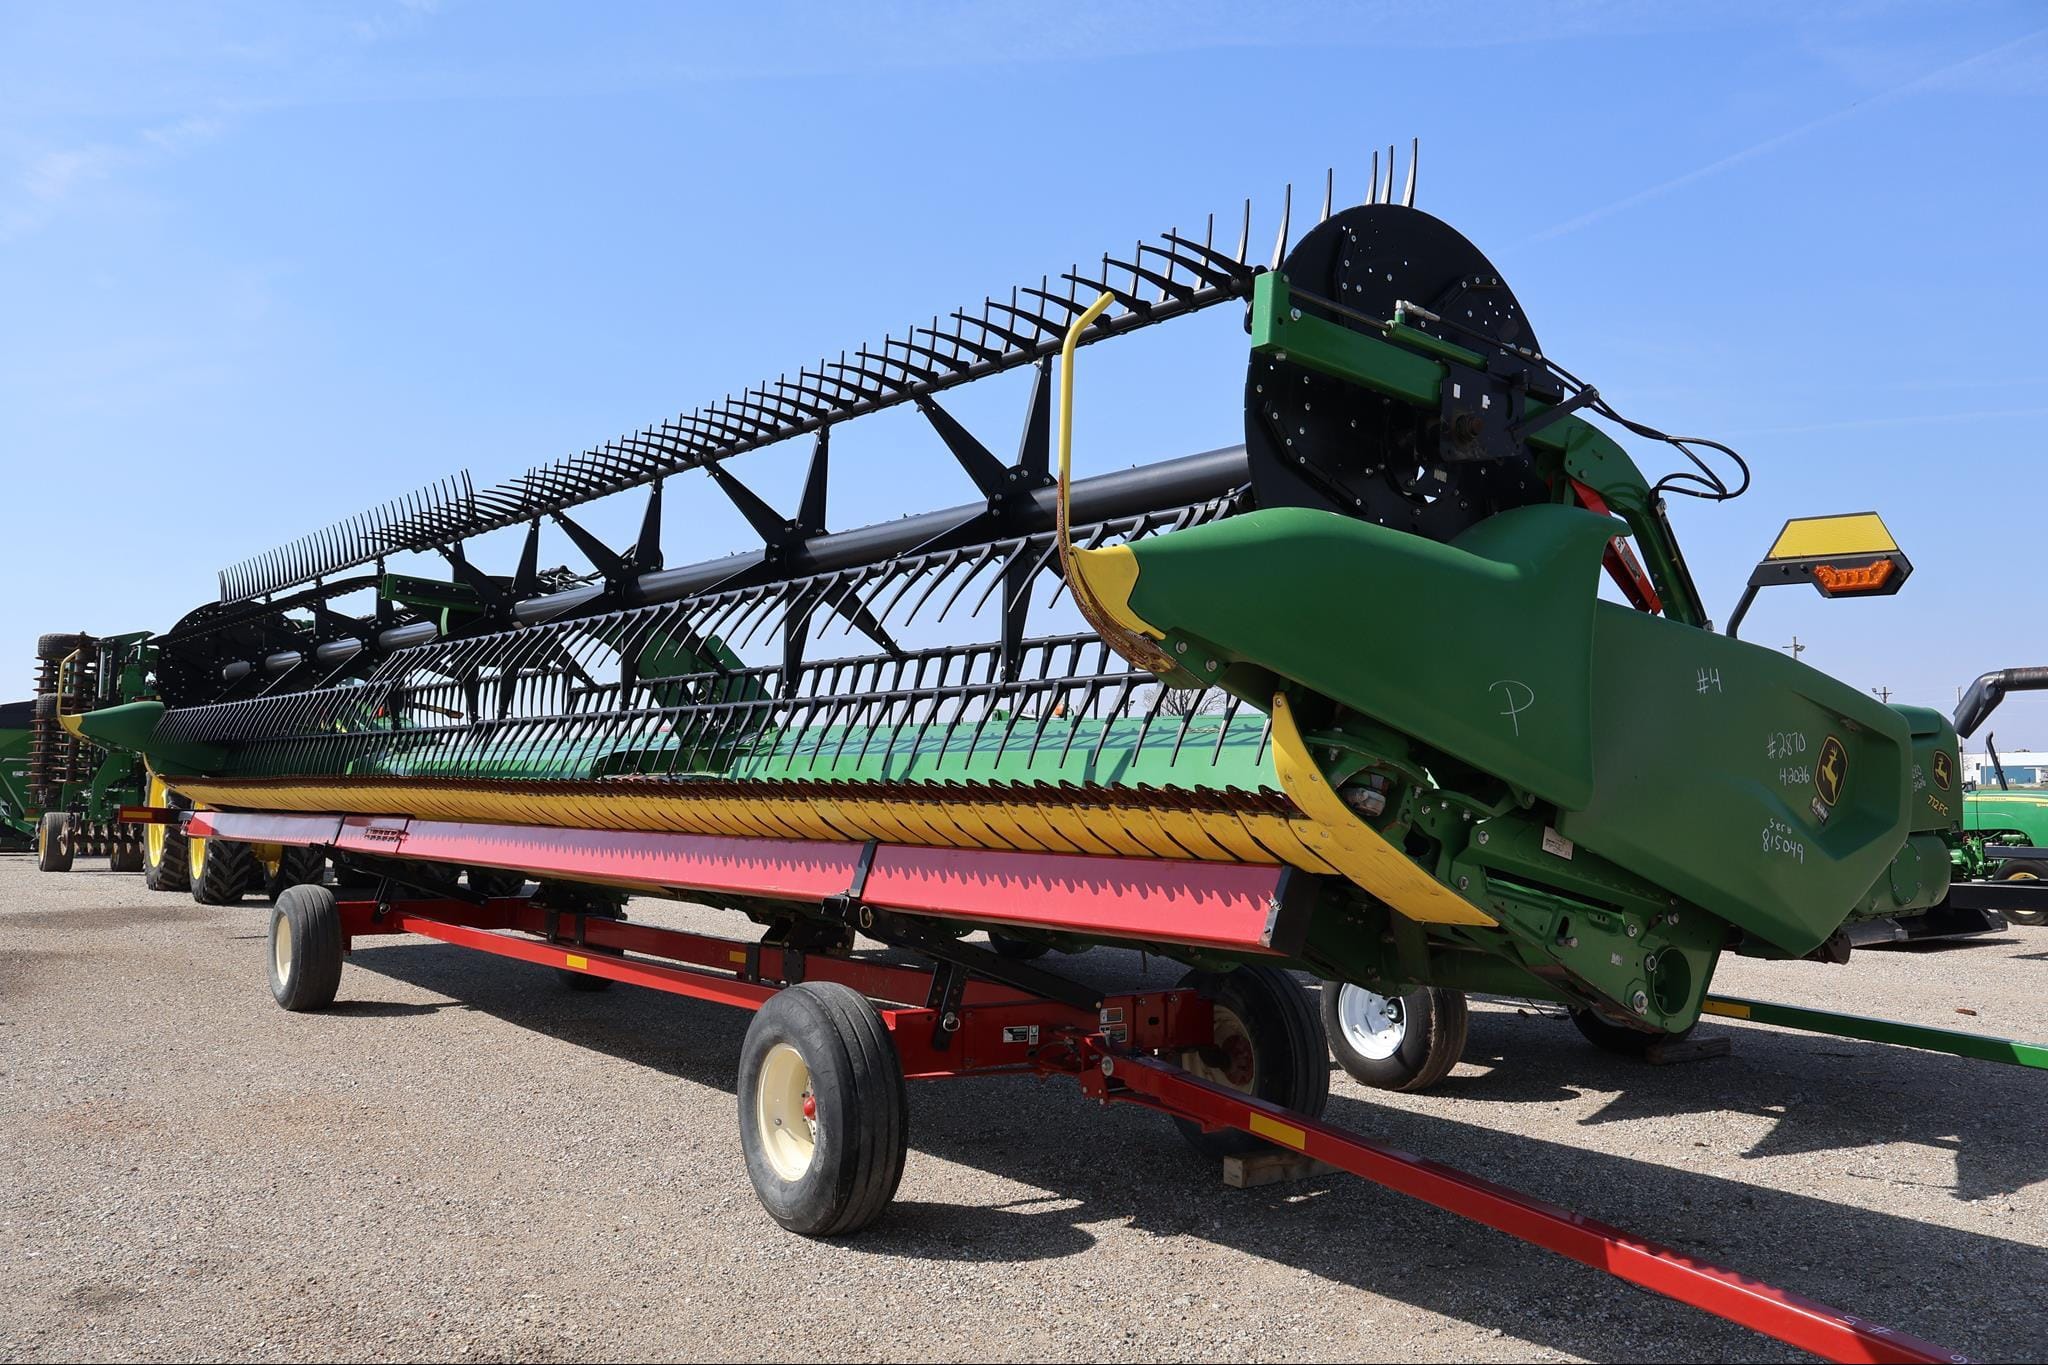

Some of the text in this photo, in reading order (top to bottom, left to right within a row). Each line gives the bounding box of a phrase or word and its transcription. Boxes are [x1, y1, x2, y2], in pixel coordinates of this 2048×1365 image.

[1696, 667, 1722, 693] #4
[1489, 680, 1535, 736] P
[1767, 731, 1806, 759] #2870
[1762, 828, 1804, 865] 815049
